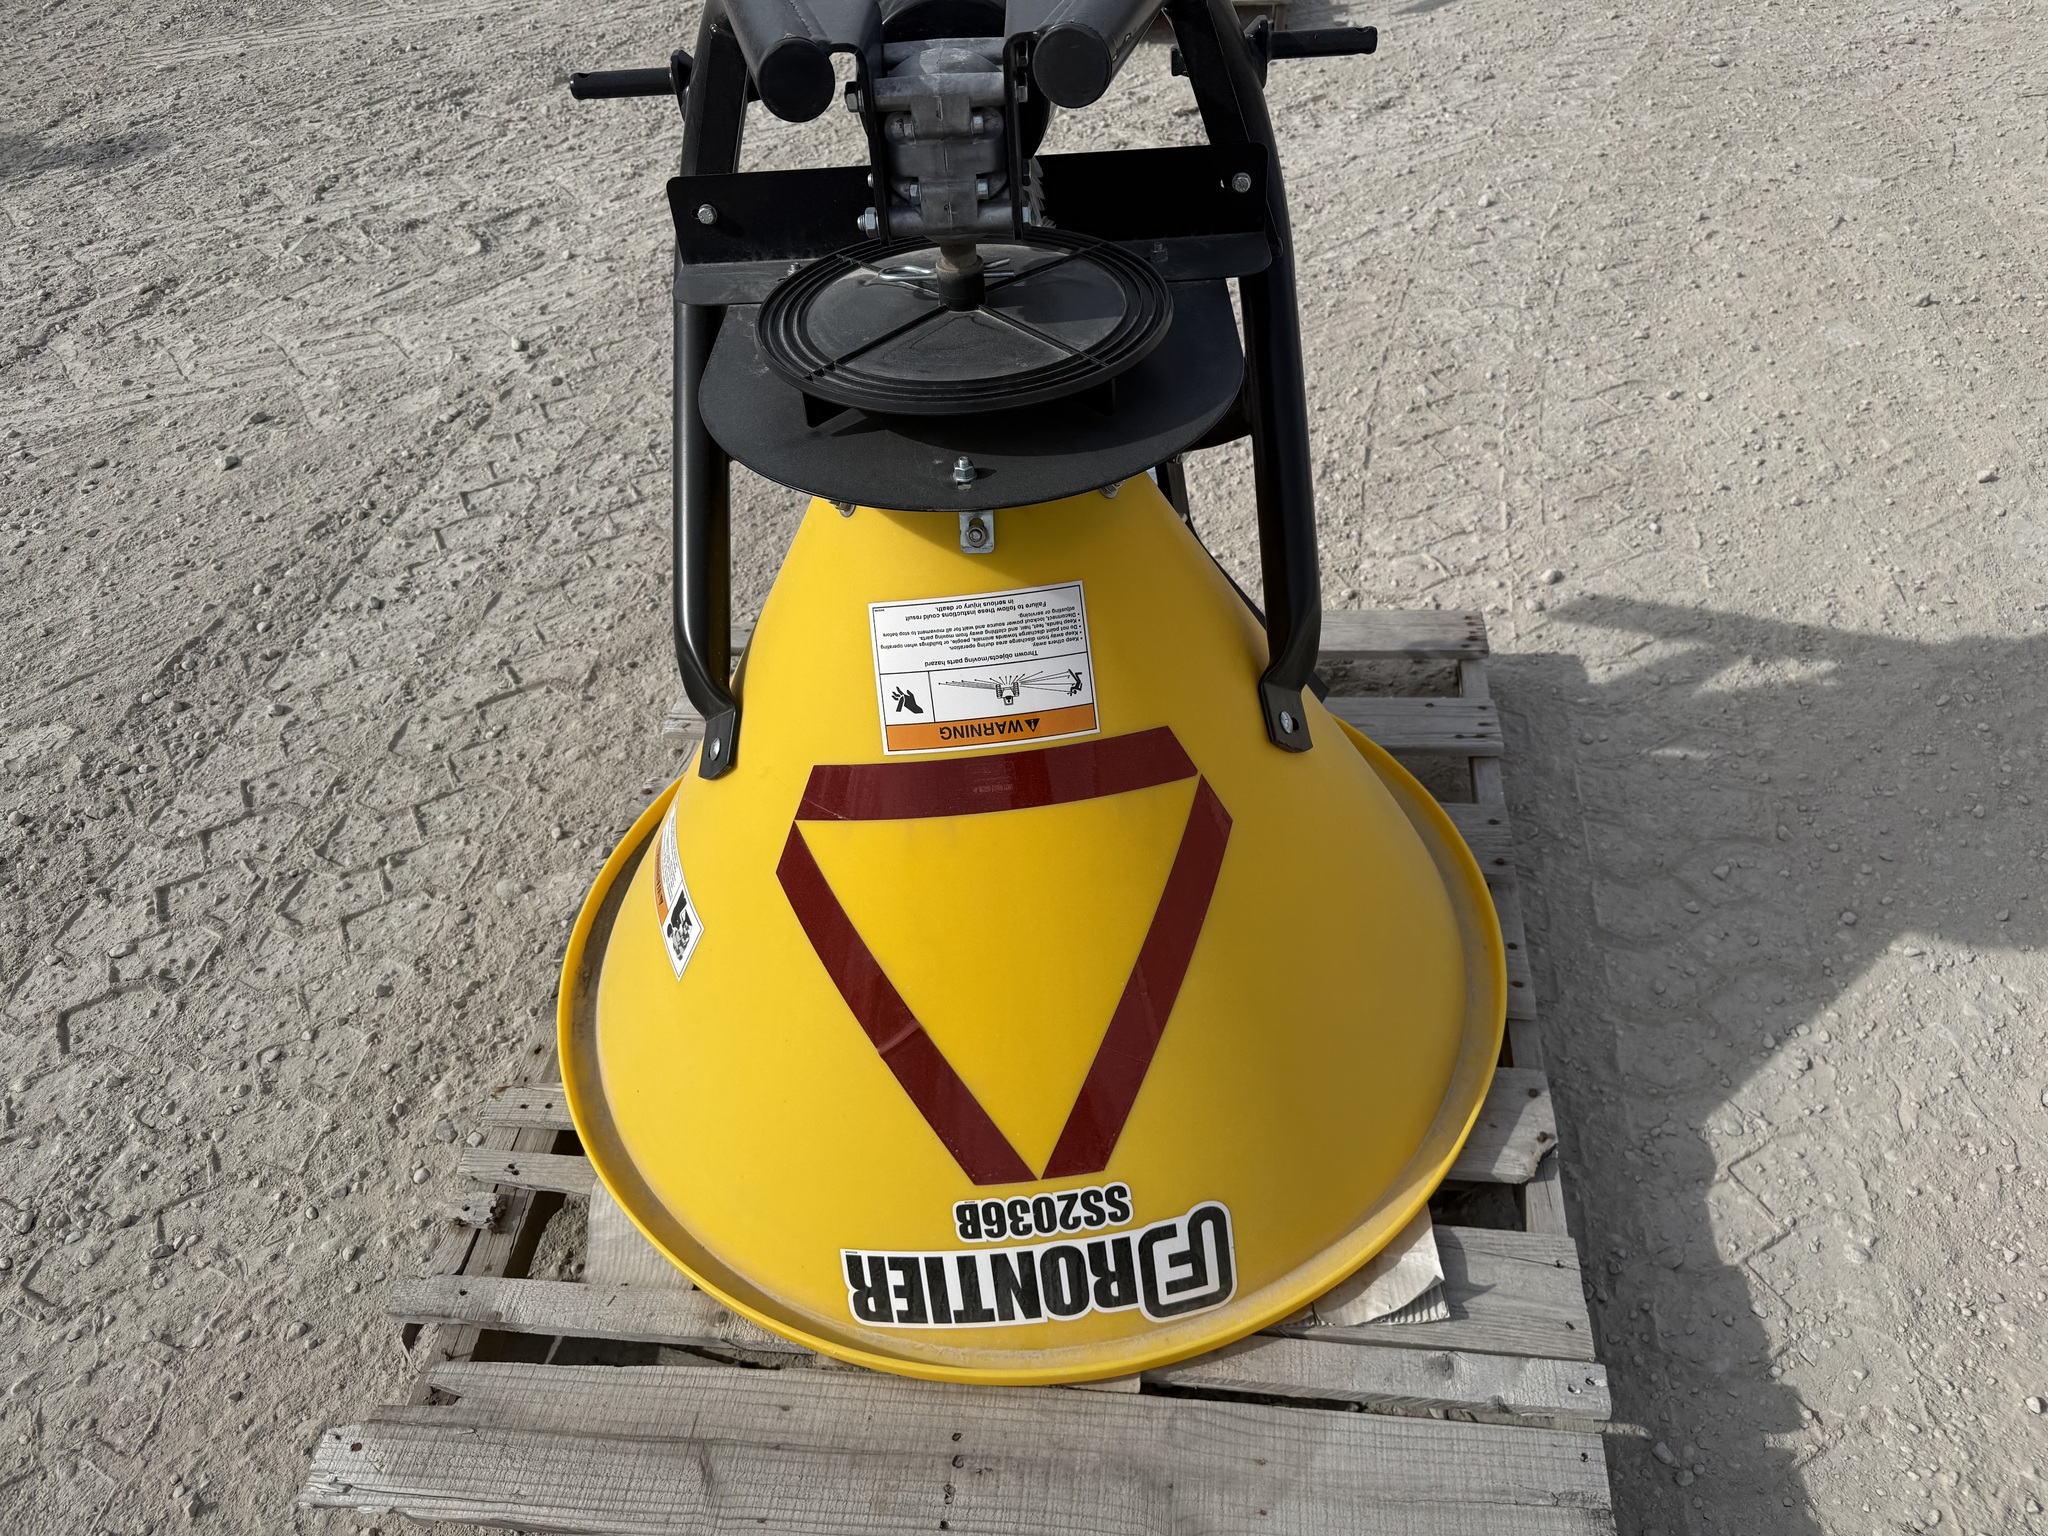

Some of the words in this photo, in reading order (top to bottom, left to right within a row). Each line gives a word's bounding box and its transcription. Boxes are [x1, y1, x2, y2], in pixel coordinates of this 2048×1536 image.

[964, 602, 981, 611] injury
[1026, 601, 1046, 609] Failure
[964, 653, 1013, 663] objects/moving
[939, 720, 1024, 740] WARNING
[955, 1186, 1130, 1240] SS2036B
[844, 1206, 1232, 1324] FRONTIER
